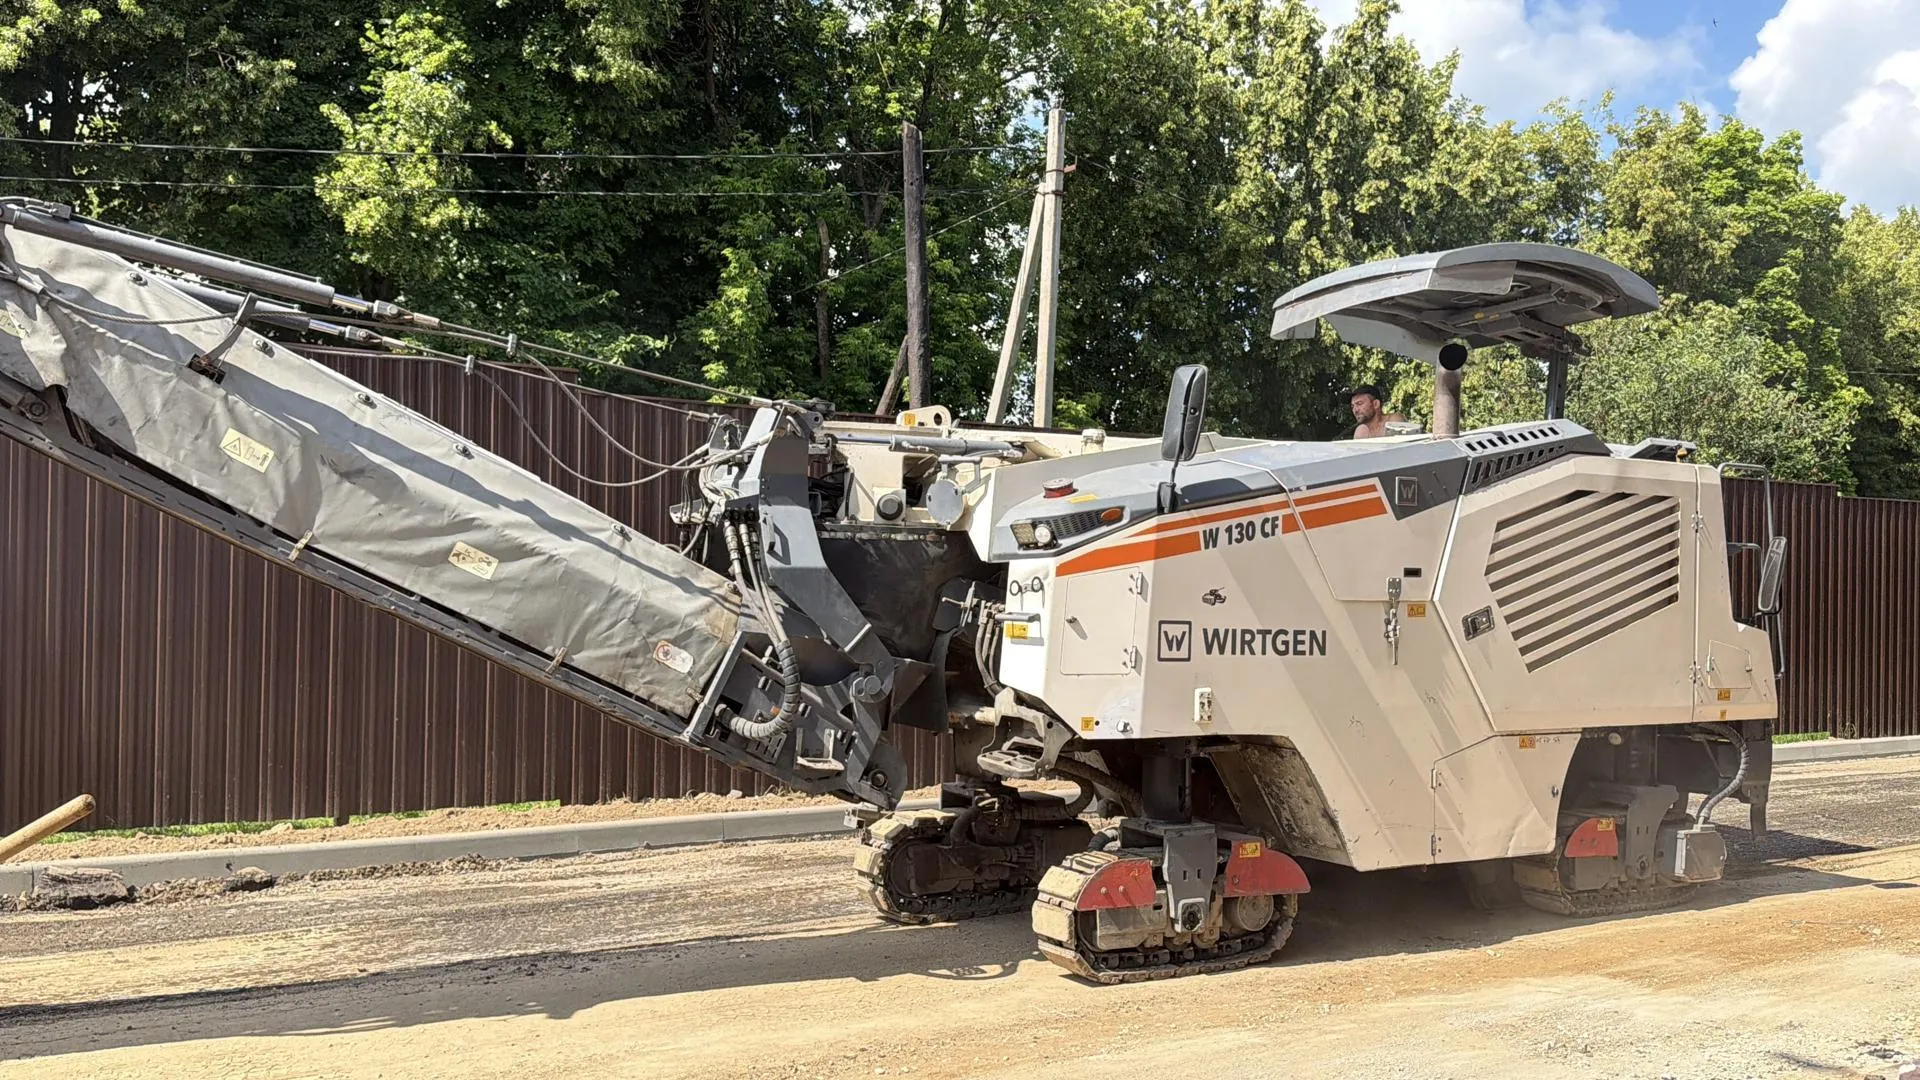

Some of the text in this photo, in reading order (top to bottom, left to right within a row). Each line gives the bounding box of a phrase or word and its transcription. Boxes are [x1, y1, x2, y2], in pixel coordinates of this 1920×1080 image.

[1400, 483, 1415, 499] W
[1202, 515, 1280, 550] W 130 CF
[1163, 627, 1327, 656] W WIRTGEN
